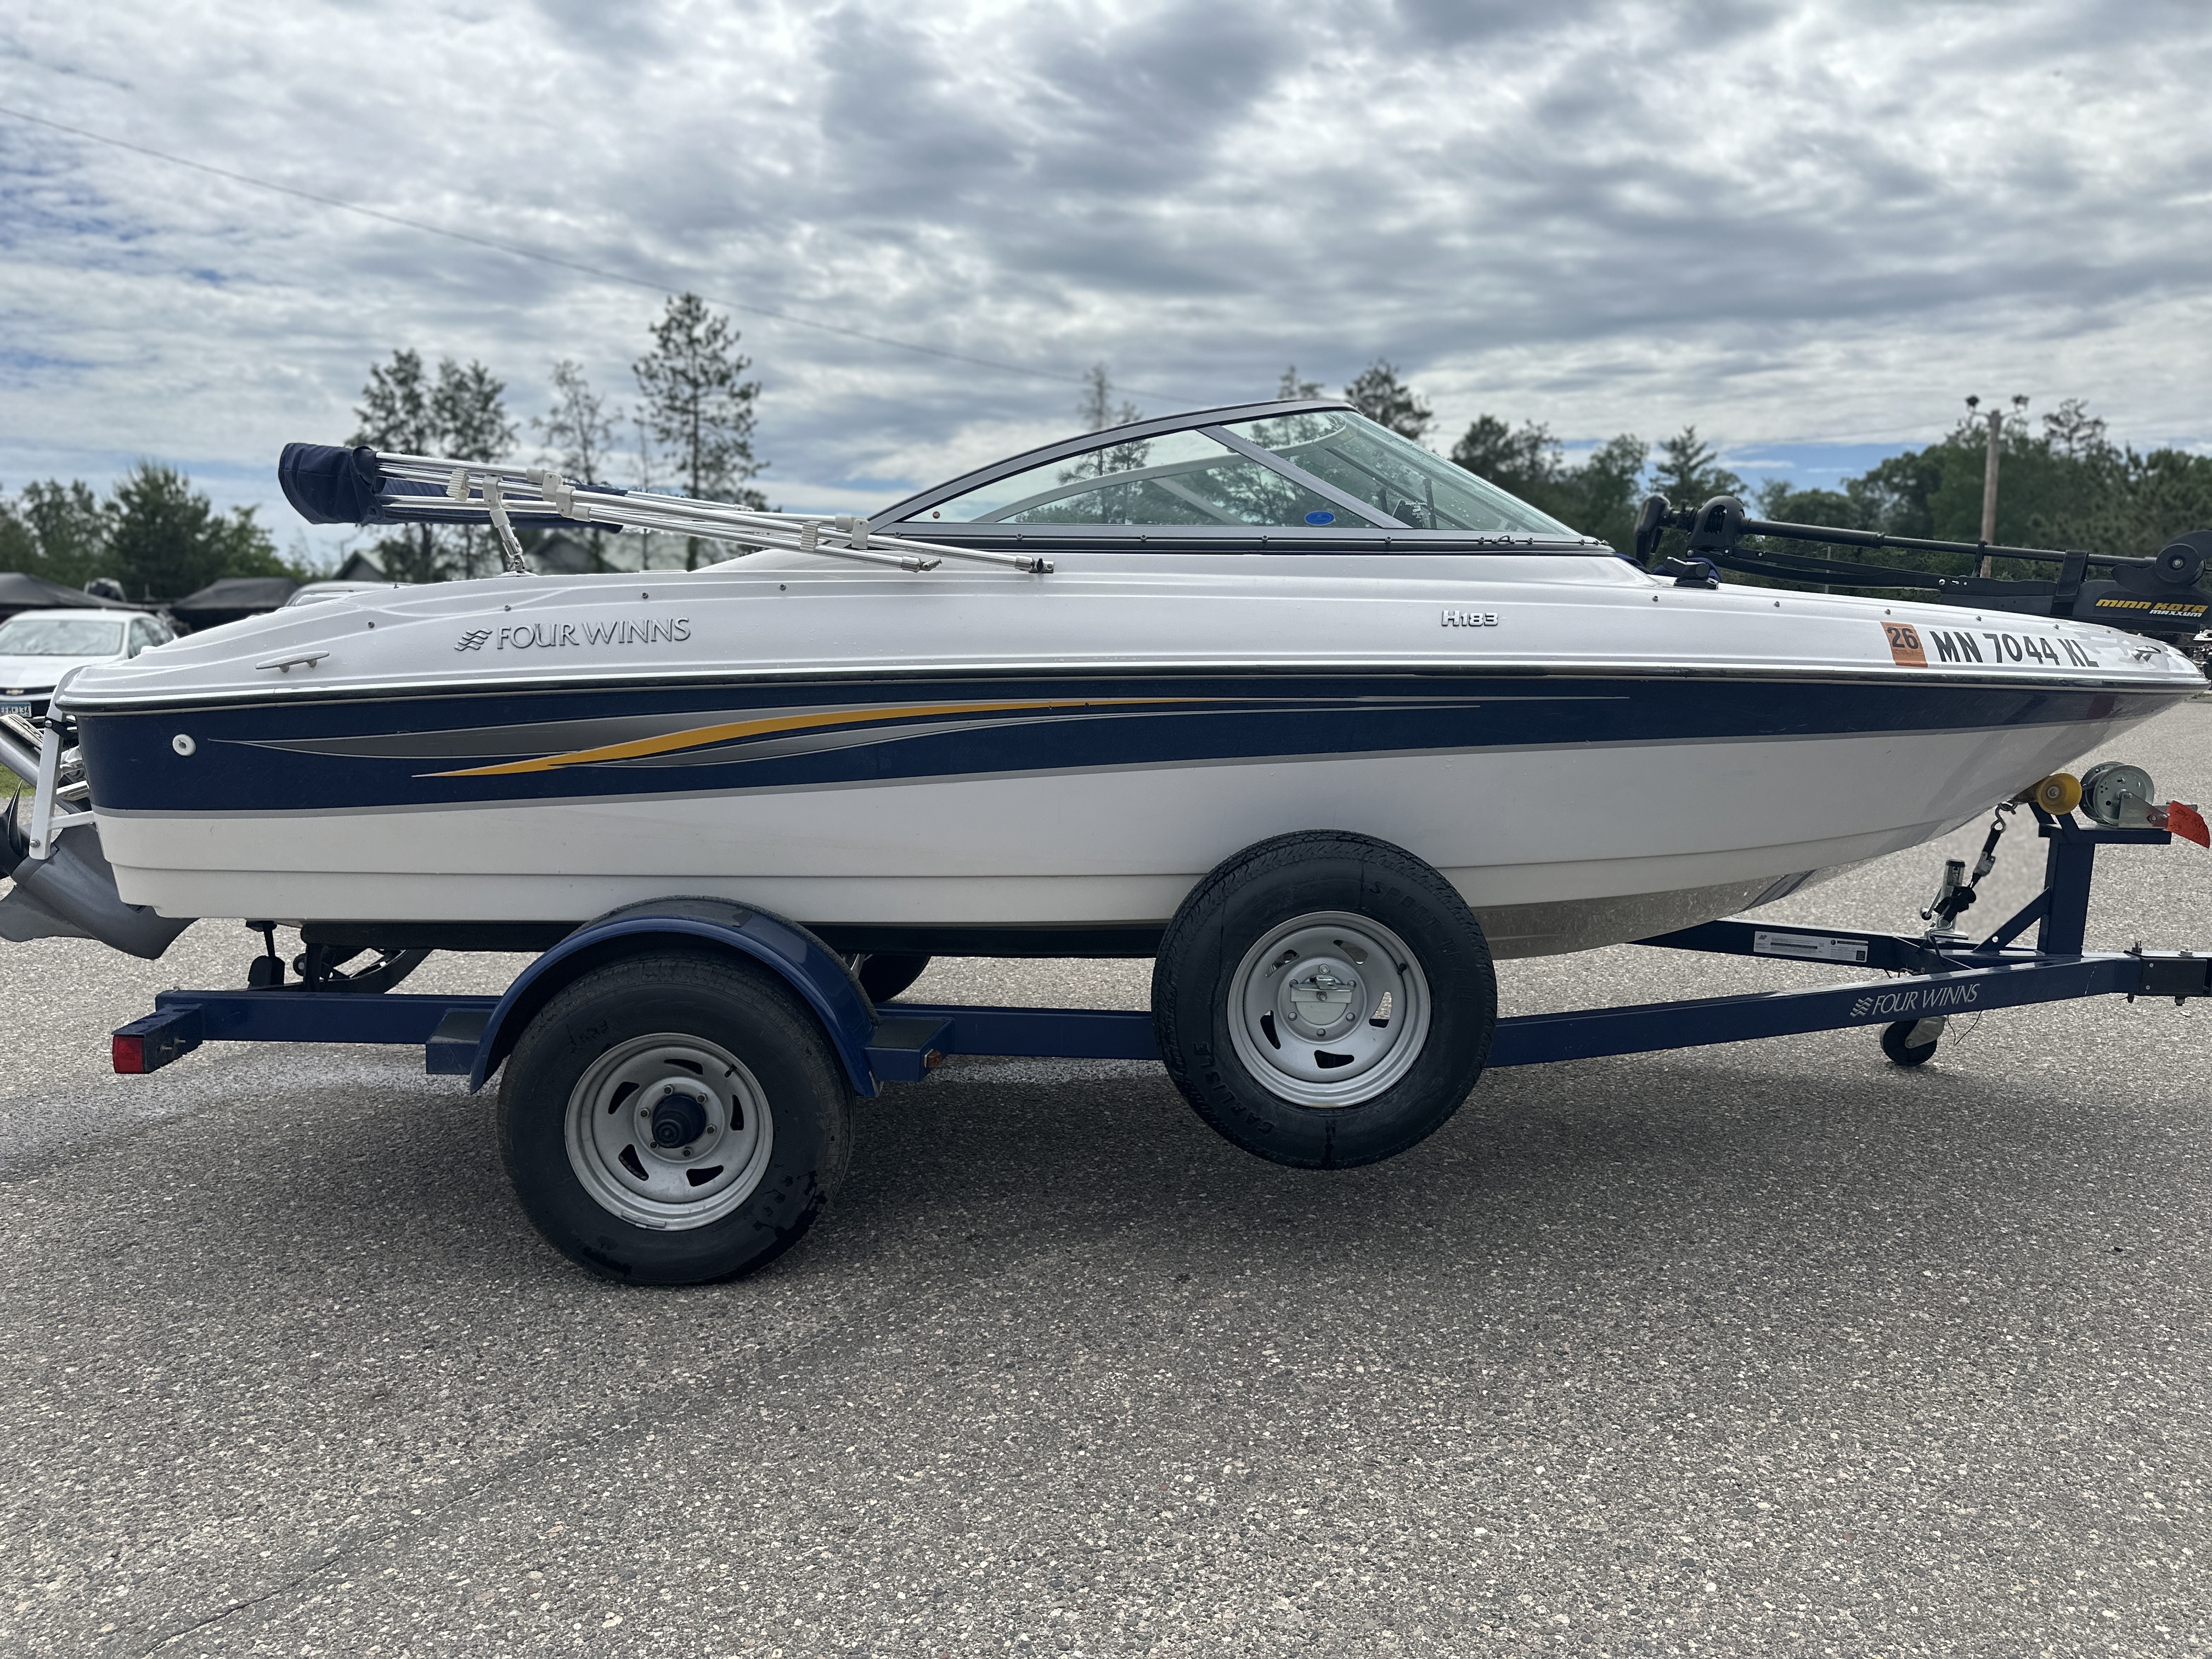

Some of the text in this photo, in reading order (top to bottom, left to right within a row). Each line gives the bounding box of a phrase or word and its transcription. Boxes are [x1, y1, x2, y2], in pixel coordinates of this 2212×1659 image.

[1441, 610, 1498, 627] H183
[2095, 599, 2208, 613] MINN KOTA
[2149, 609, 2203, 617] MAXXUM
[497, 617, 691, 650] FOUR WINNS
[1887, 627, 1919, 650] 26
[1929, 631, 1983, 663] MN
[1982, 633, 2060, 665] 7044
[1369, 880, 1475, 1005] SPORT TRAIL
[1871, 983, 1980, 1015] FOUR WINNS
[1192, 1041, 1275, 1137] CARLISLE
